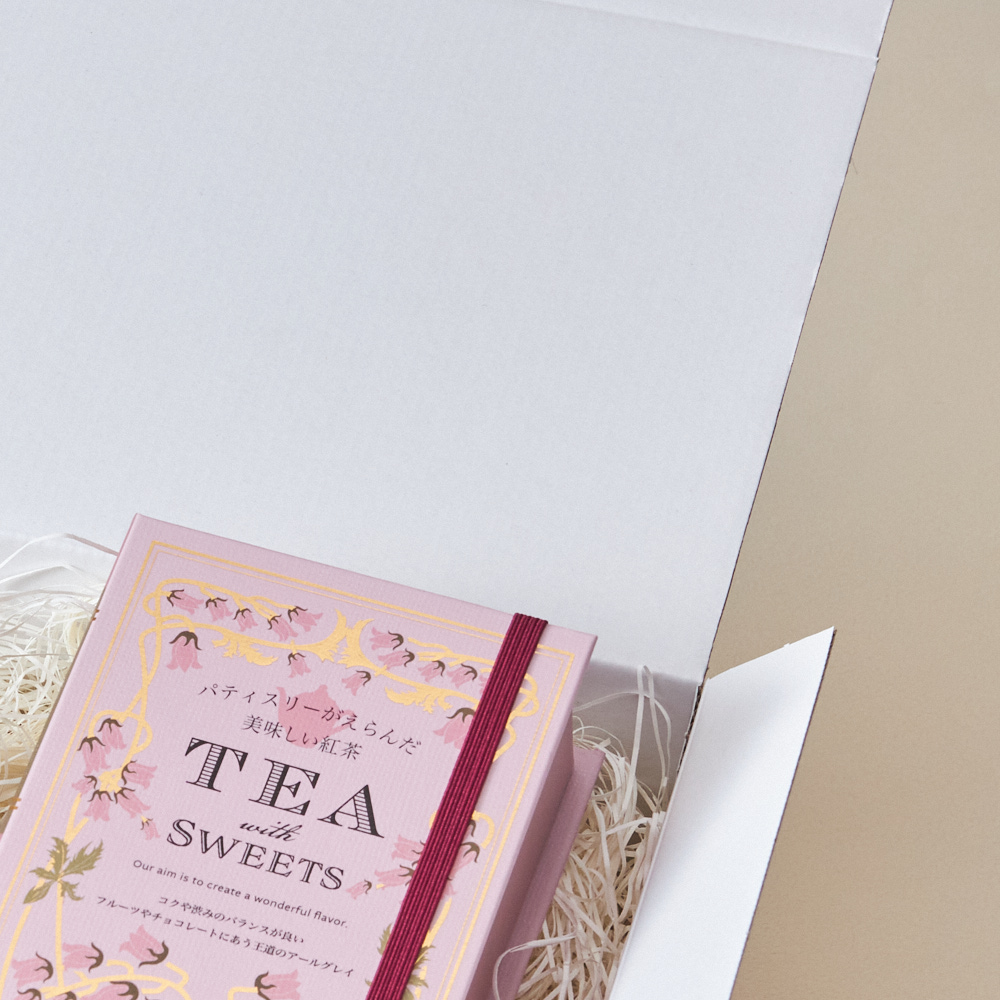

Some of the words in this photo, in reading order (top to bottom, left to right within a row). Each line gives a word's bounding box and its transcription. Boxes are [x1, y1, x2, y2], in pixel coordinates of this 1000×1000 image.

[198, 683, 422, 755] パティスリーがえらんだ
[241, 714, 363, 760] 美味しい紅茶
[184, 737, 385, 839] TEA
[166, 818, 345, 891] SWEETS
[239, 820, 303, 843] with
[133, 859, 154, 872] Our
[156, 867, 177, 879] aim
[180, 872, 189, 883] is
[192, 877, 204, 887] to
[206, 881, 241, 898] create
[244, 892, 250, 900] a
[254, 895, 312, 918] wonderful
[313, 910, 348, 929] flavor.
[159, 896, 304, 944] コクや渋みのバランスが良い
[97, 896, 354, 977] フルーツやチョコレートにあう王道のアールグレイ
